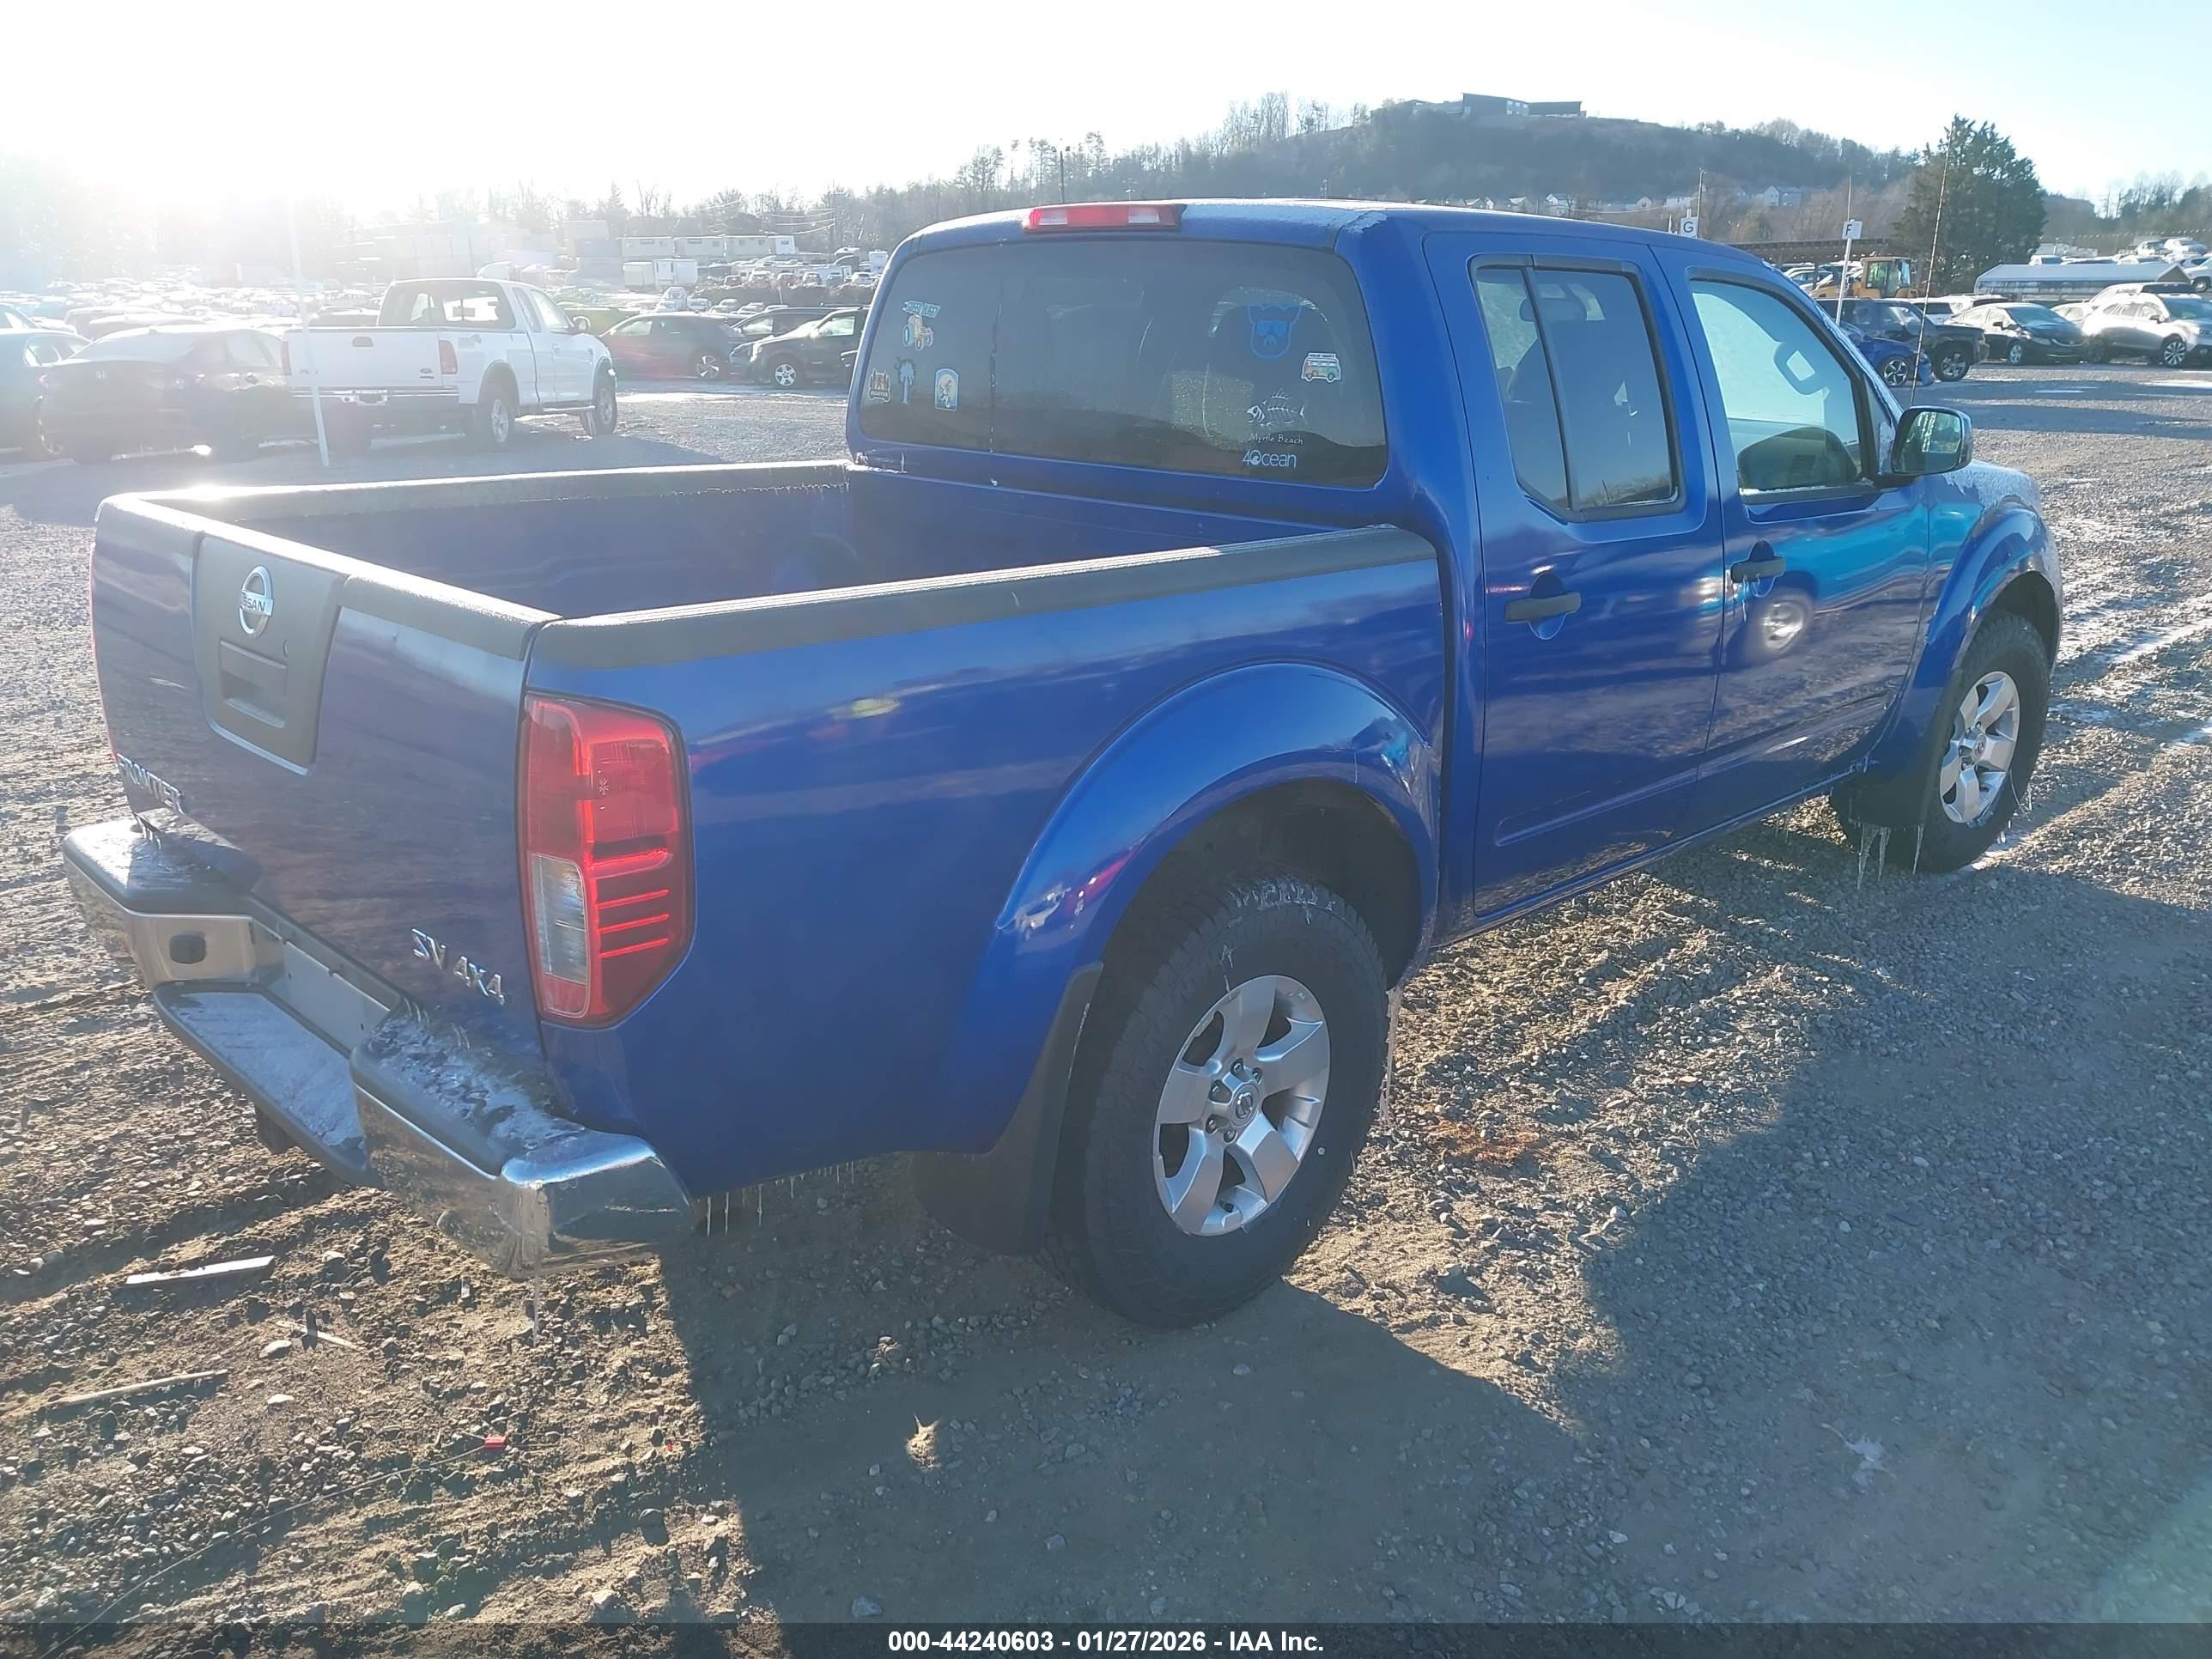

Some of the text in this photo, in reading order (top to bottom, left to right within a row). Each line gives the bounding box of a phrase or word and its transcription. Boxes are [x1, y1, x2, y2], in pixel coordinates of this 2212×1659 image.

[1683, 221, 1694, 234] G
[1845, 223, 1853, 236] F
[1249, 432, 1304, 445] Myrtle Beach
[411, 927, 447, 970] SV
